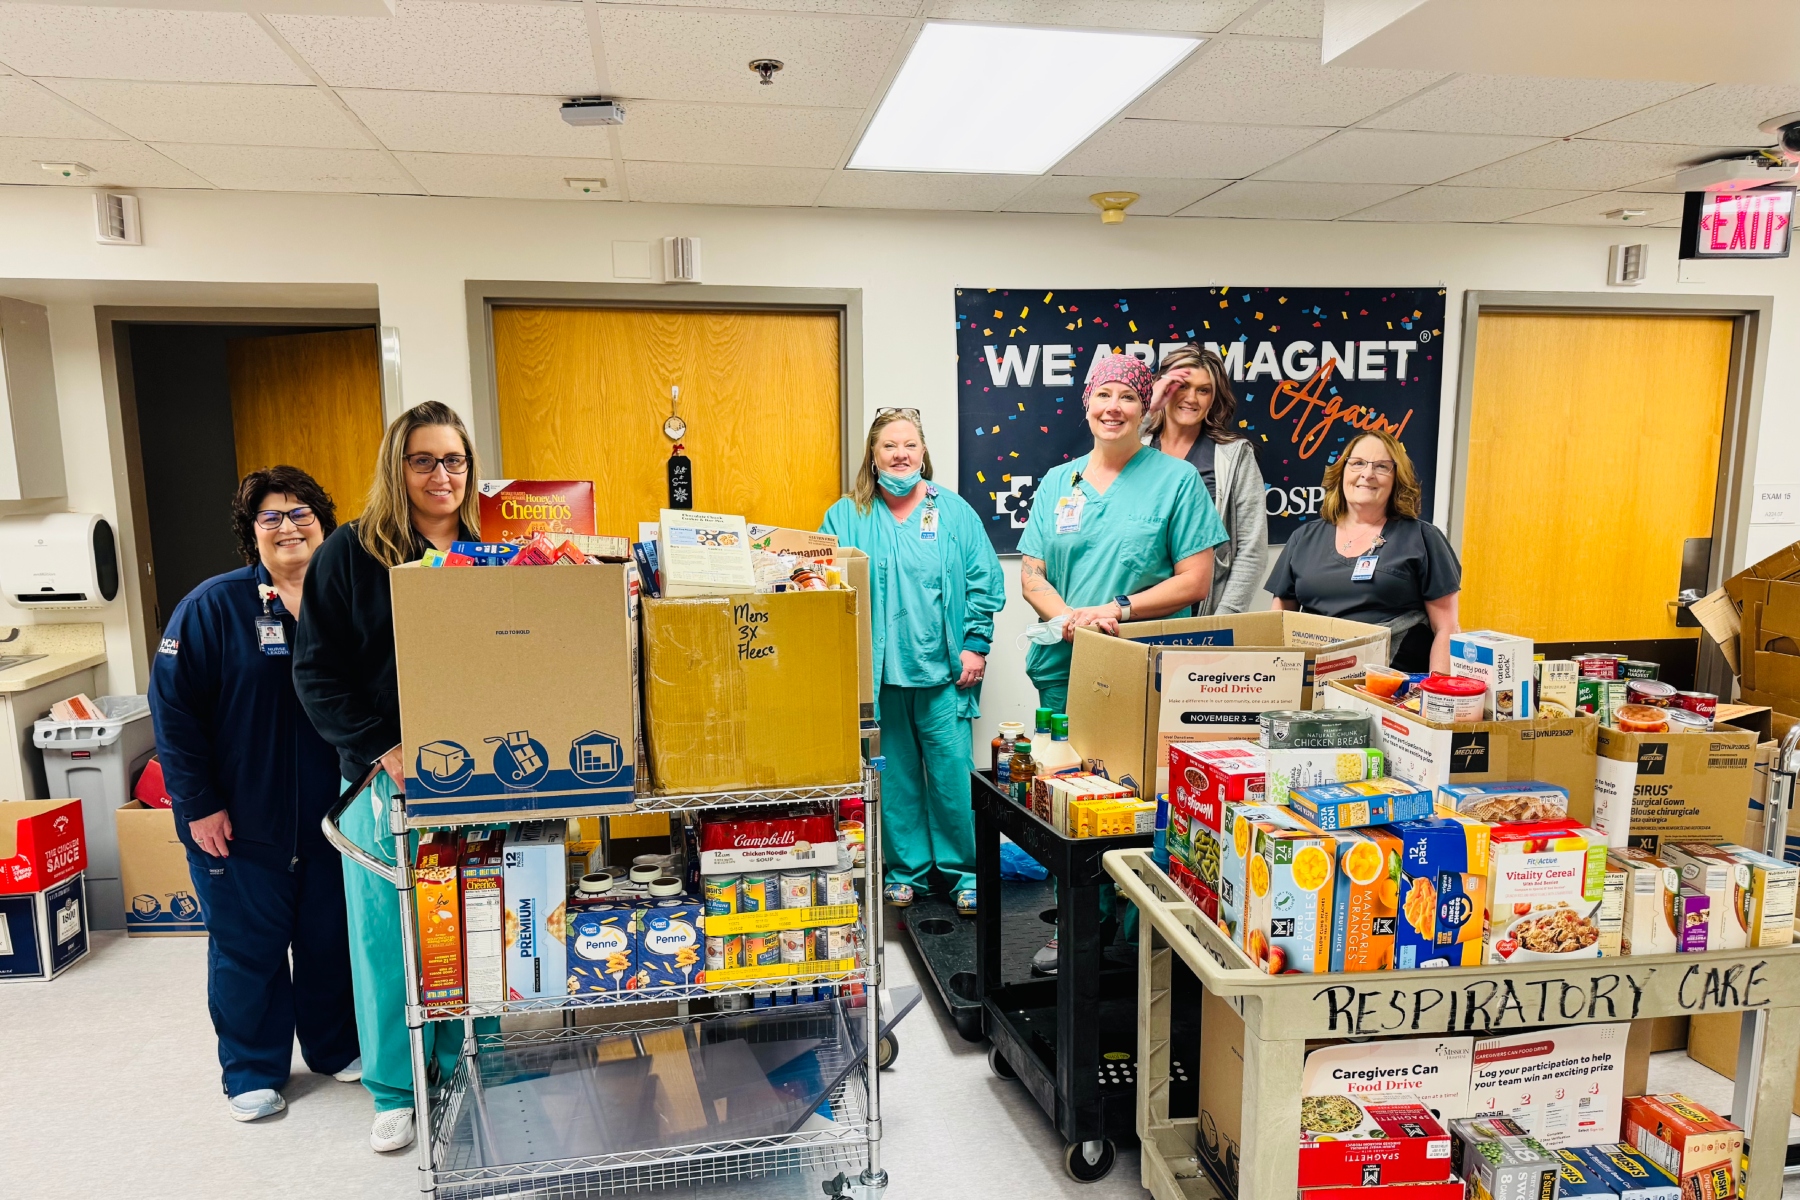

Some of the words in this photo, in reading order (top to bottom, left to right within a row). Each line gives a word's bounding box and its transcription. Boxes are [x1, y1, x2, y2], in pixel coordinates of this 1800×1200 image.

[1711, 196, 1780, 249] EXIT
[984, 345, 1074, 387] WE
[526, 494, 550, 504] Honey
[552, 494, 566, 502] Nut
[501, 500, 572, 520] Cheerios
[778, 547, 833, 558] Cinnamon
[734, 603, 769, 625] Mens
[738, 625, 758, 641] 3X
[737, 641, 775, 661] Fleece
[1453, 661, 1474, 673] variety
[1474, 667, 1489, 676] pack
[1188, 672, 1250, 683] Caregivers
[1253, 672, 1276, 682] Can
[1200, 684, 1228, 693] Food
[1231, 684, 1262, 693] Drive
[1427, 694, 1443, 702] Nutrition
[1190, 714, 1240, 722] NOVEMBER
[1241, 714, 1247, 722] 3
[1294, 738, 1334, 747] CHICKEN
[1337, 735, 1368, 746] BREAST
[1523, 731, 1534, 739] REF
[1536, 730, 1574, 738] DYNJP2362P
[1605, 780, 1616, 788] help
[1603, 788, 1617, 796] prize
[1632, 798, 1662, 807] Surgical
[1656, 808, 1699, 817] chirurgicale
[733, 830, 795, 848] Campbell's
[1640, 838, 1655, 849] XL
[45, 849, 57, 860] THE
[57, 838, 80, 855] CHICKEN
[1276, 844, 1288, 861] 24
[1409, 847, 1419, 860] 12
[1418, 837, 1429, 865] pack
[46, 847, 80, 873] SAUCE
[506, 851, 517, 869] 12
[1506, 870, 1543, 882] Vitality
[1545, 867, 1576, 878] Cereal
[466, 880, 497, 890] Cheerios
[1339, 902, 1345, 910] IN
[1453, 897, 1461, 924] cheese
[519, 898, 532, 958] PREMIUM
[1302, 892, 1317, 962] PEACHES
[1347, 894, 1362, 961] ORANGES
[1358, 890, 1373, 965] MANDARIN
[586, 940, 618, 950] Penne
[656, 935, 687, 944] Penne
[1312, 968, 1657, 1035] RESPIRATORY
[1678, 960, 1771, 1010] CARE
[1444, 1048, 1470, 1056] MISSION
[1476, 1051, 1507, 1060] CAREGIVERS
[1332, 1066, 1409, 1081] Caregivers
[1412, 1064, 1439, 1075] Can
[1480, 1070, 1497, 1079] Log
[1499, 1067, 1520, 1077] your
[1521, 1058, 1579, 1075] participation
[1580, 1055, 1590, 1063] to
[1591, 1053, 1612, 1062] help
[1475, 1081, 1496, 1090] your
[1498, 1077, 1522, 1086] team
[1524, 1075, 1540, 1083] win
[1554, 1066, 1589, 1078] exciting
[1590, 1063, 1614, 1074] prize
[1347, 1081, 1382, 1093] Food
[1385, 1079, 1423, 1090] Drive
[1486, 1096, 1496, 1109] 1
[1520, 1093, 1531, 1105] 2
[1555, 1088, 1565, 1100] 3
[1588, 1082, 1599, 1094] 4
[1672, 1103, 1709, 1122] BUSH'S
[1345, 1153, 1400, 1162] SPAGHETTI
[1515, 1150, 1539, 1162] 8
[1612, 1153, 1646, 1177] BUSH'S
[1500, 1174, 1513, 1184] 8
[1715, 1169, 1728, 1198] BUSH'S
